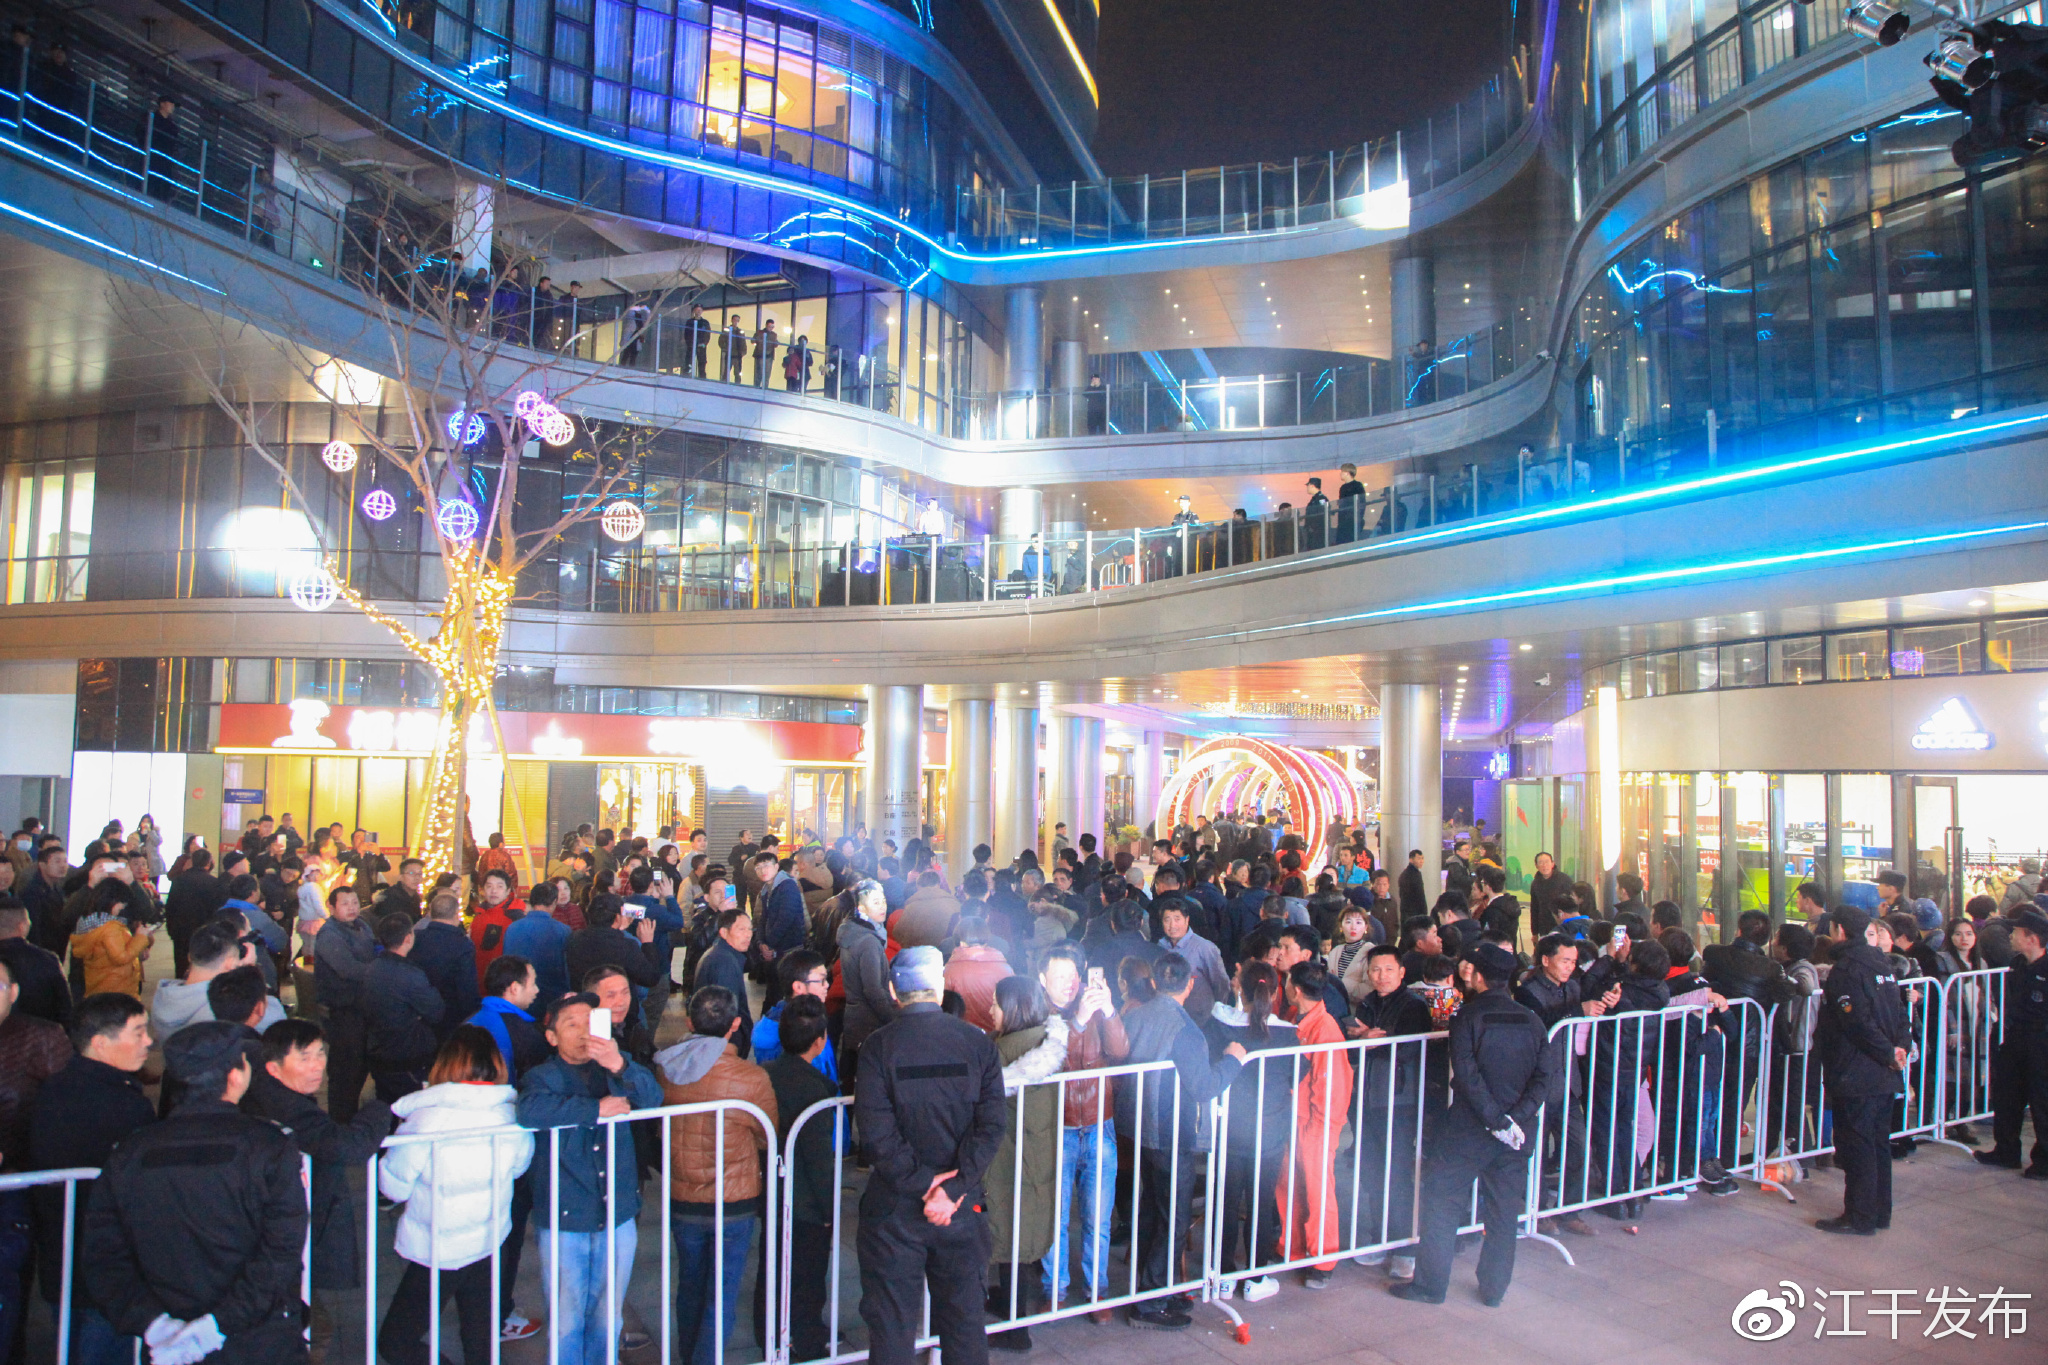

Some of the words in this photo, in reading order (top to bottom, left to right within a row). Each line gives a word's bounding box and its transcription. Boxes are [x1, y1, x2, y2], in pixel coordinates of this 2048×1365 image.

[1220, 739, 1241, 748] 2009
[1252, 744, 1273, 761] 2011
[1279, 770, 1295, 792] 2013
